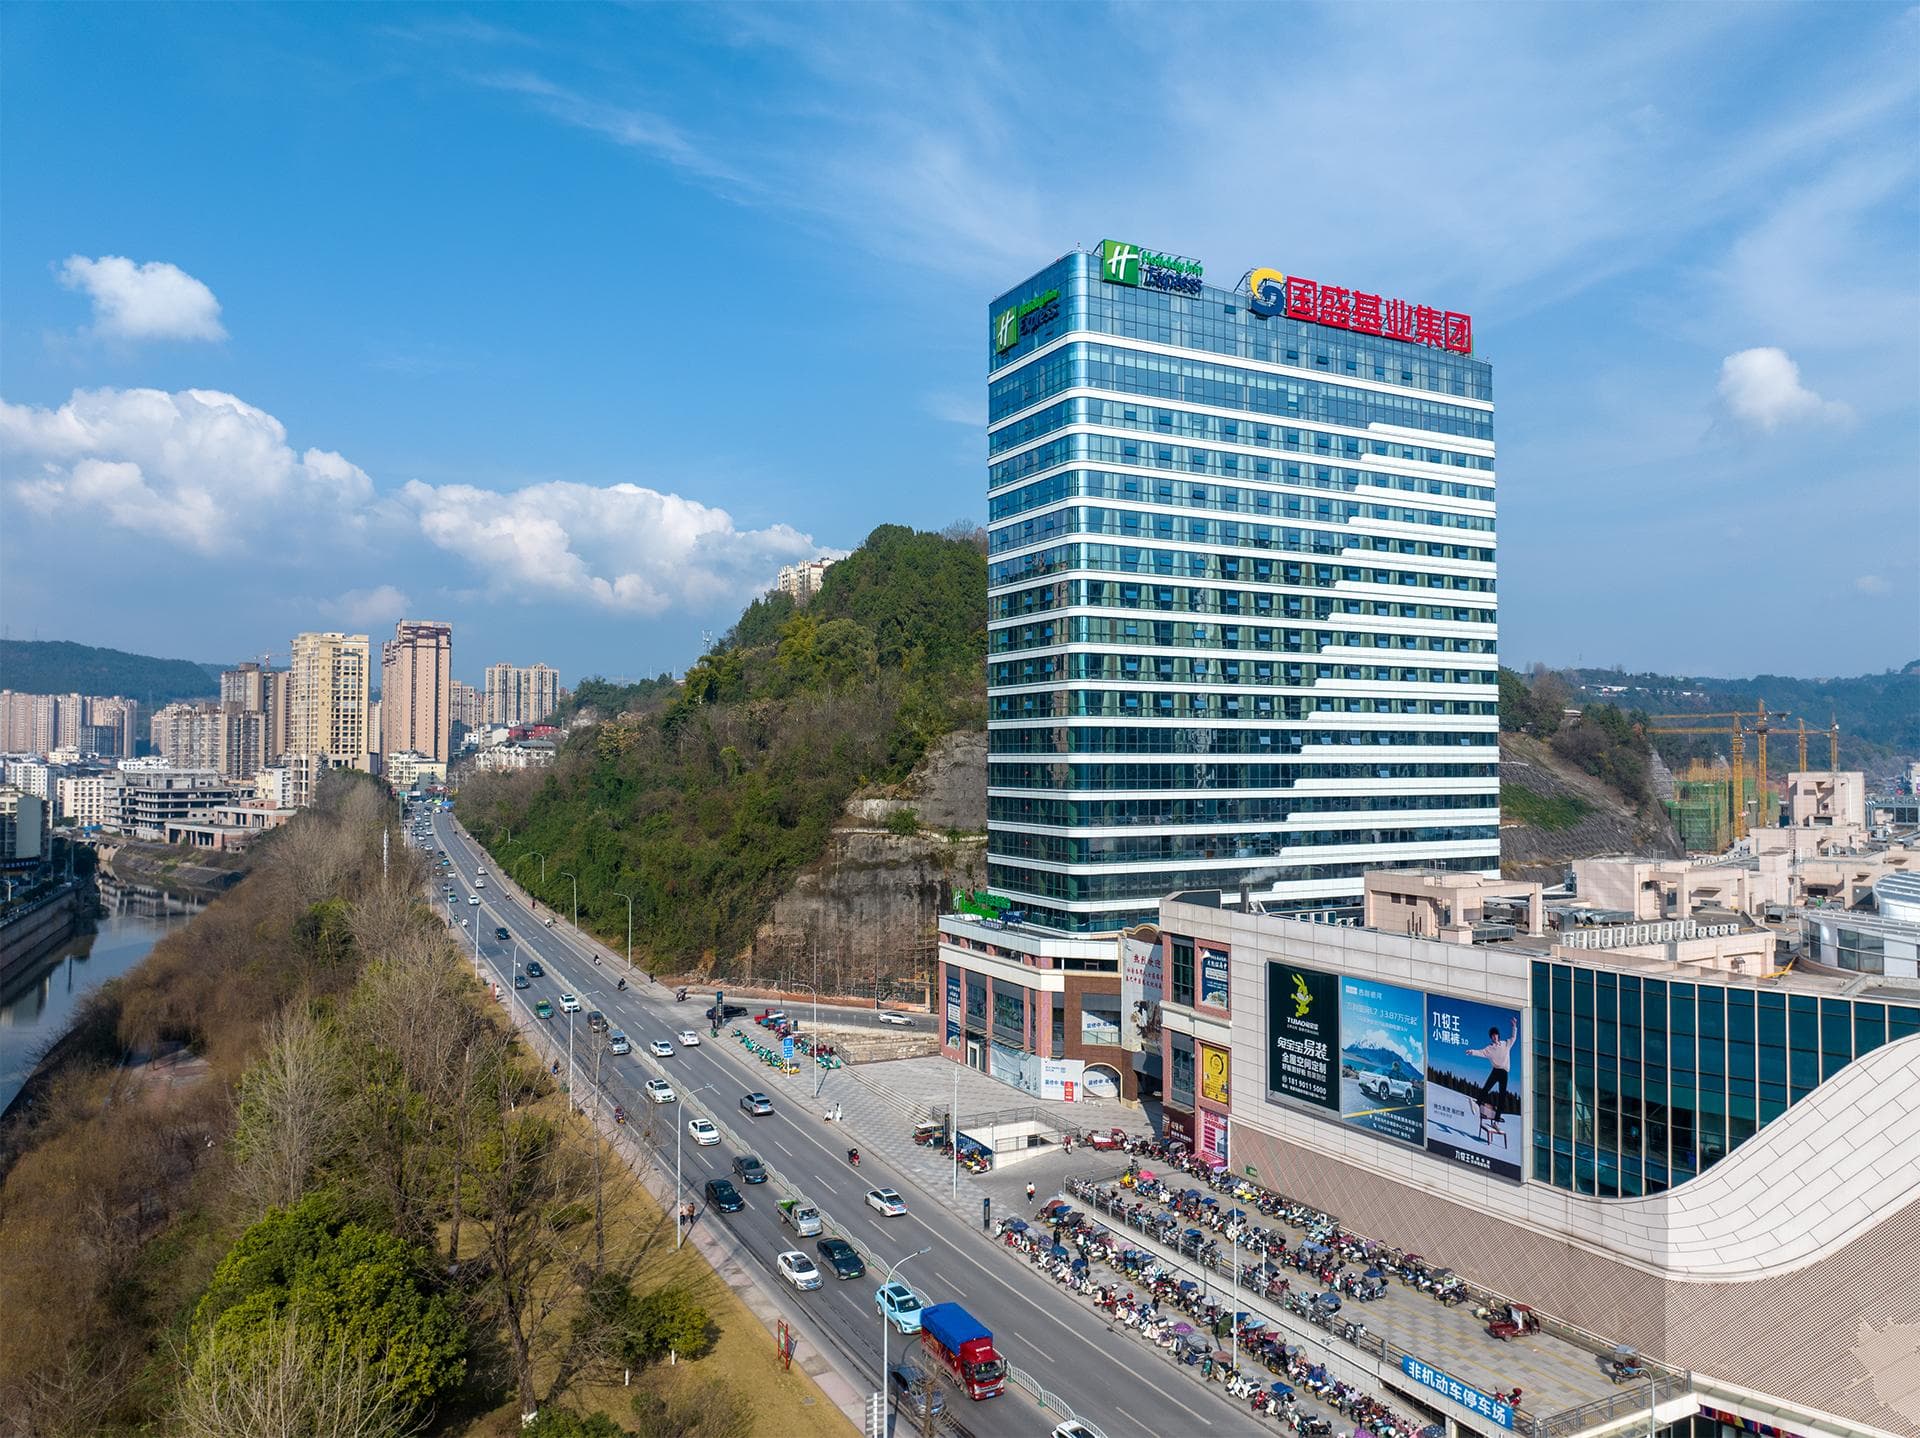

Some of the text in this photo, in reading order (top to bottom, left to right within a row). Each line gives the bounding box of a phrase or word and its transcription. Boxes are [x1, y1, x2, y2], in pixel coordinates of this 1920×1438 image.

[1141, 251, 1185, 273] Holiday
[1286, 275, 1472, 353] 国盛基业集团
[1432, 1011, 1460, 1032] 九牧王
[1432, 1028, 1460, 1046] 小黑裤
[1408, 1360, 1506, 1425] 非机动车停车场
